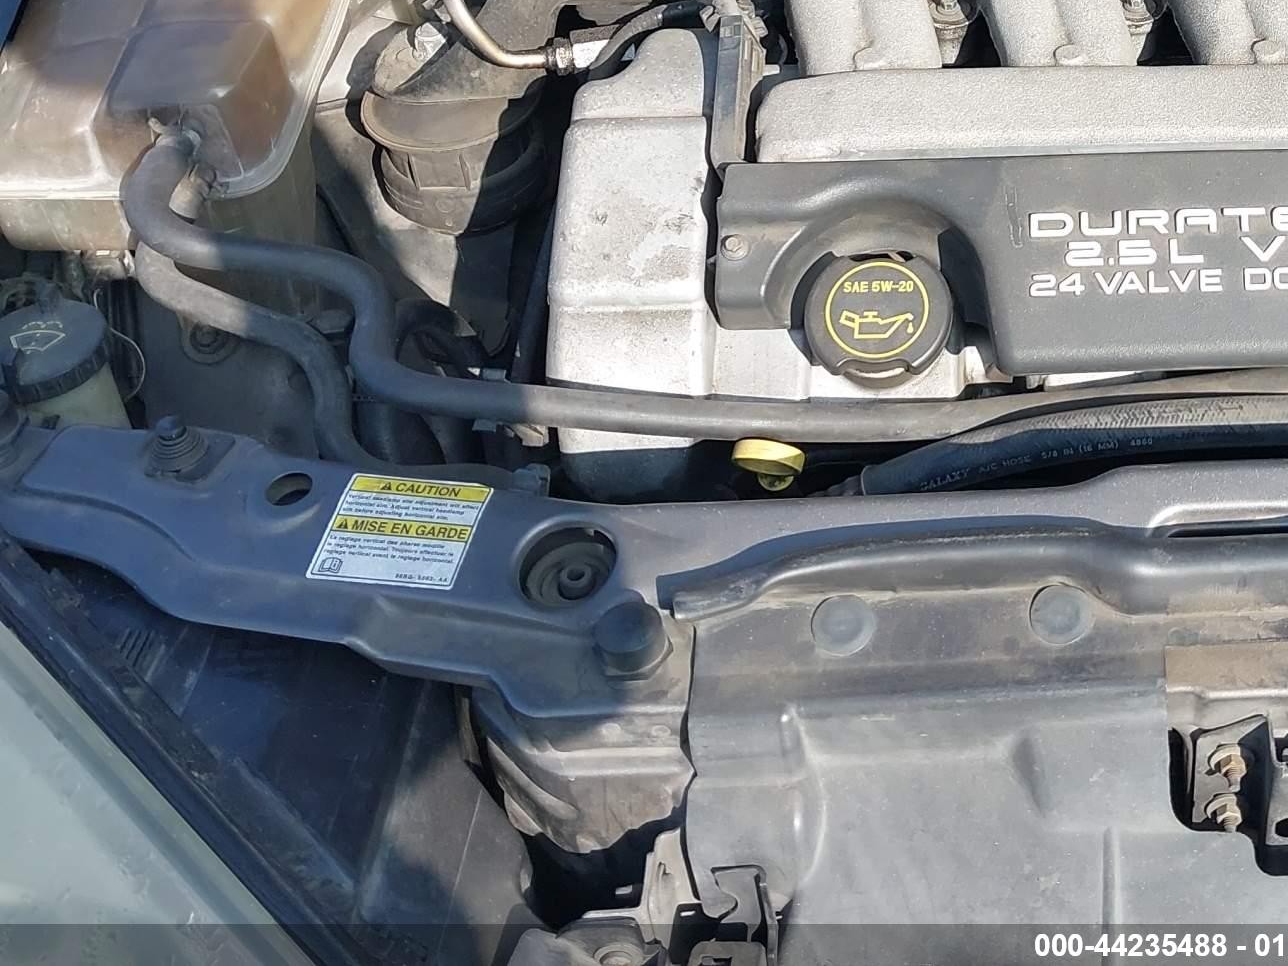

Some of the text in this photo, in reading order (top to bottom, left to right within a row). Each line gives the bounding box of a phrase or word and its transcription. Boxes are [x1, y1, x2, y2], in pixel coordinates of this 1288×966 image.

[843, 280, 914, 293] SAE 5W-20
[1029, 272, 1085, 297] 24
[1094, 268, 1223, 295] VALVE
[395, 482, 461, 497] CAUTION
[352, 520, 468, 539] MISE EN GARDE
